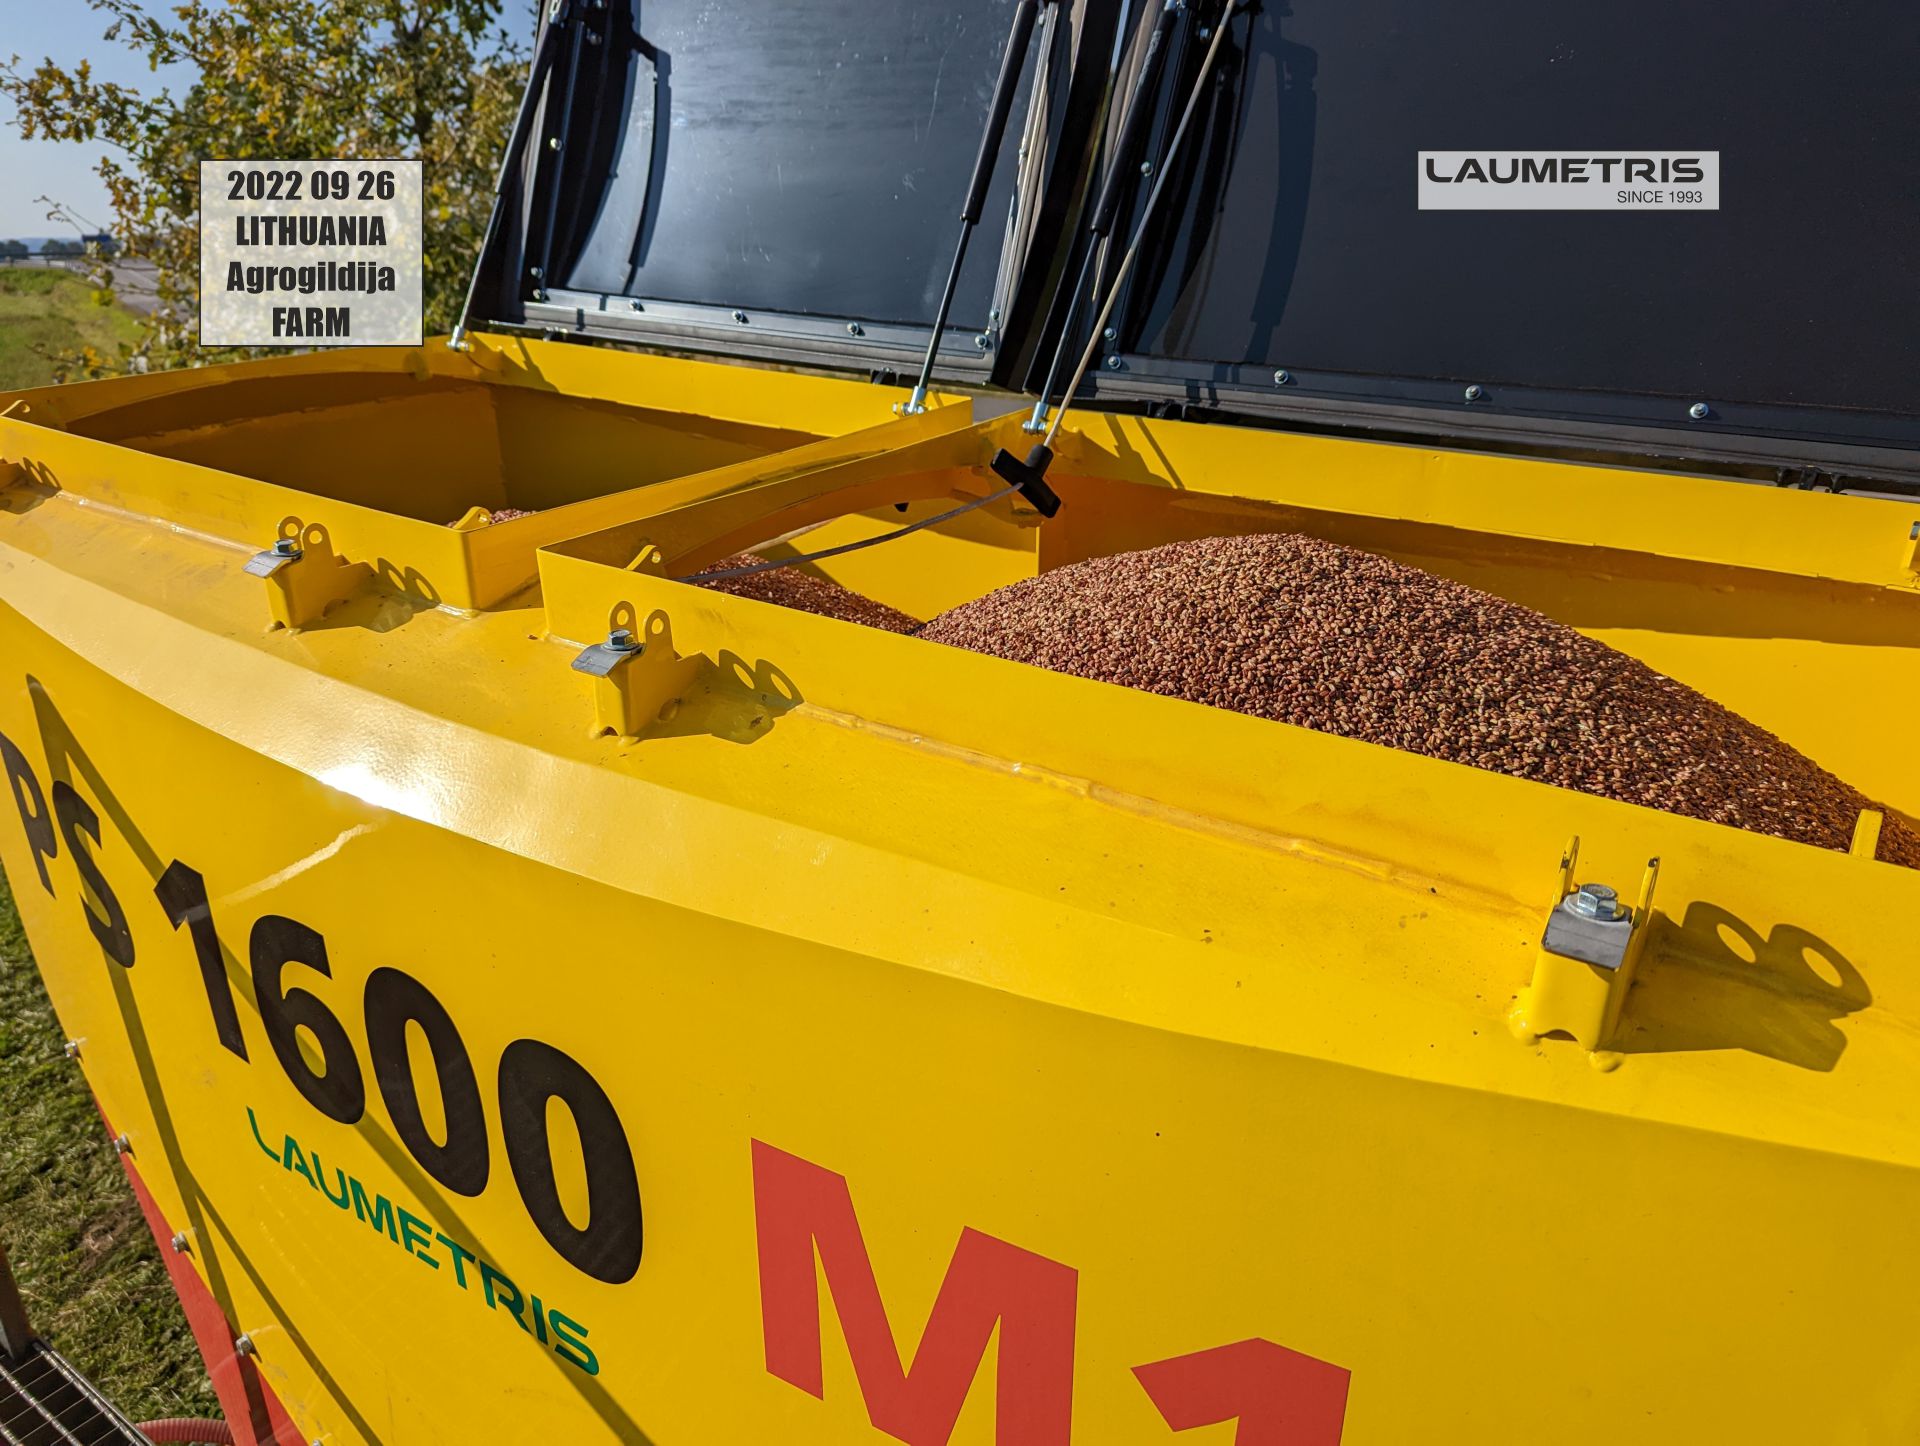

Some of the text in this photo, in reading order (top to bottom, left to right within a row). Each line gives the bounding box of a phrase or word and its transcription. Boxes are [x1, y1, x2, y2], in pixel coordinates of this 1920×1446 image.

[0, 731, 643, 1284] PS 1600
[247, 1107, 599, 1376] LAUMETRIS
